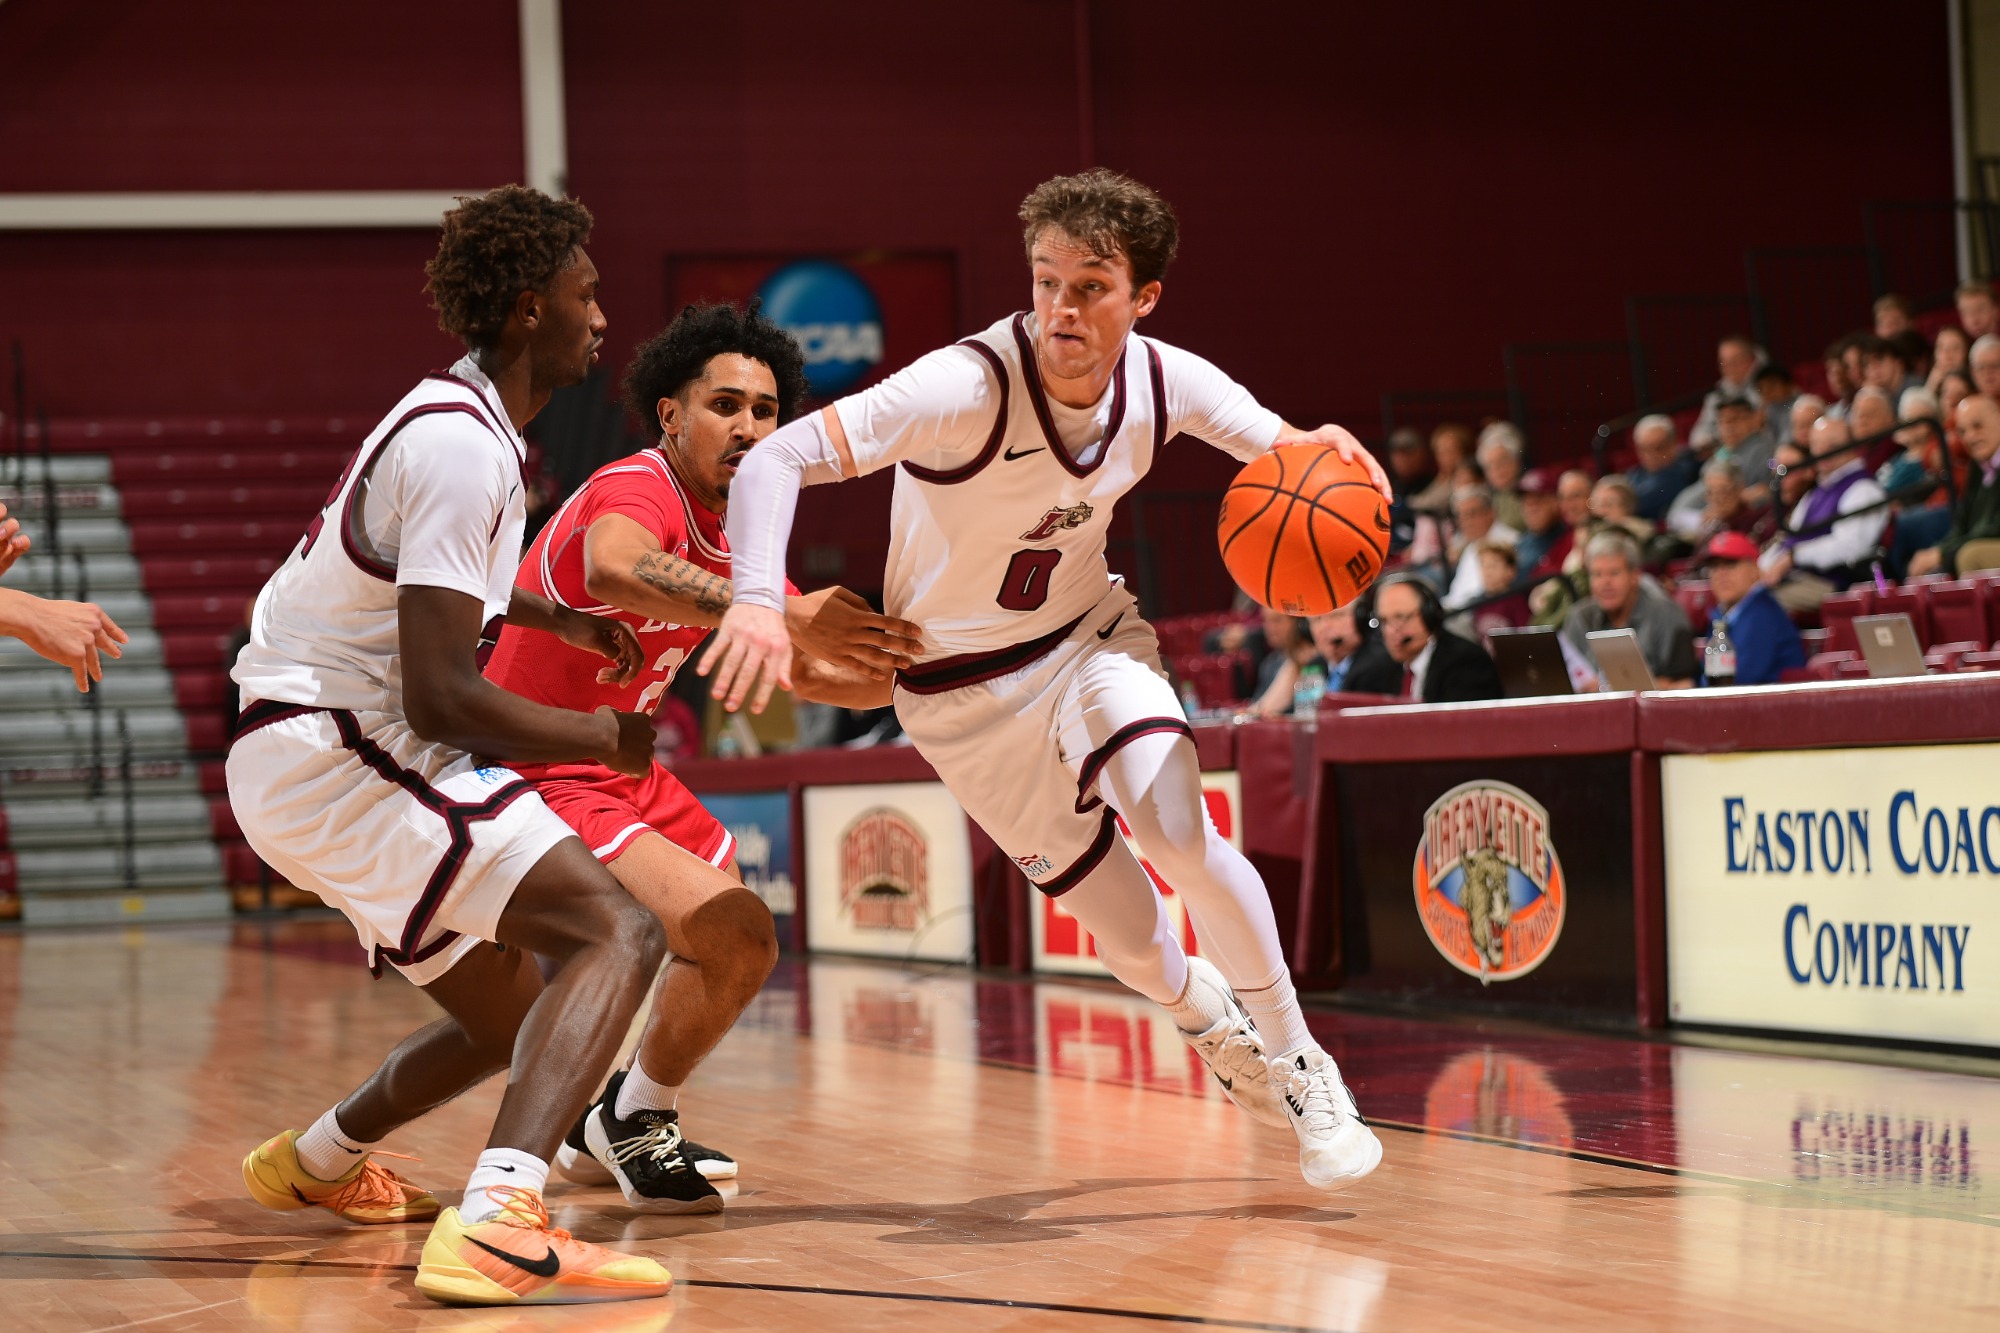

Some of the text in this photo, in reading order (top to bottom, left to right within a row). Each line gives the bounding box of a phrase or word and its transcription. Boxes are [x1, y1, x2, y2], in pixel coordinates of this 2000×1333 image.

[996, 549, 1063, 612] 0
[1426, 787, 1548, 890] LAFAYETTE
[1722, 795, 1872, 873] EASTON
[1783, 903, 1971, 990] COMPANY
